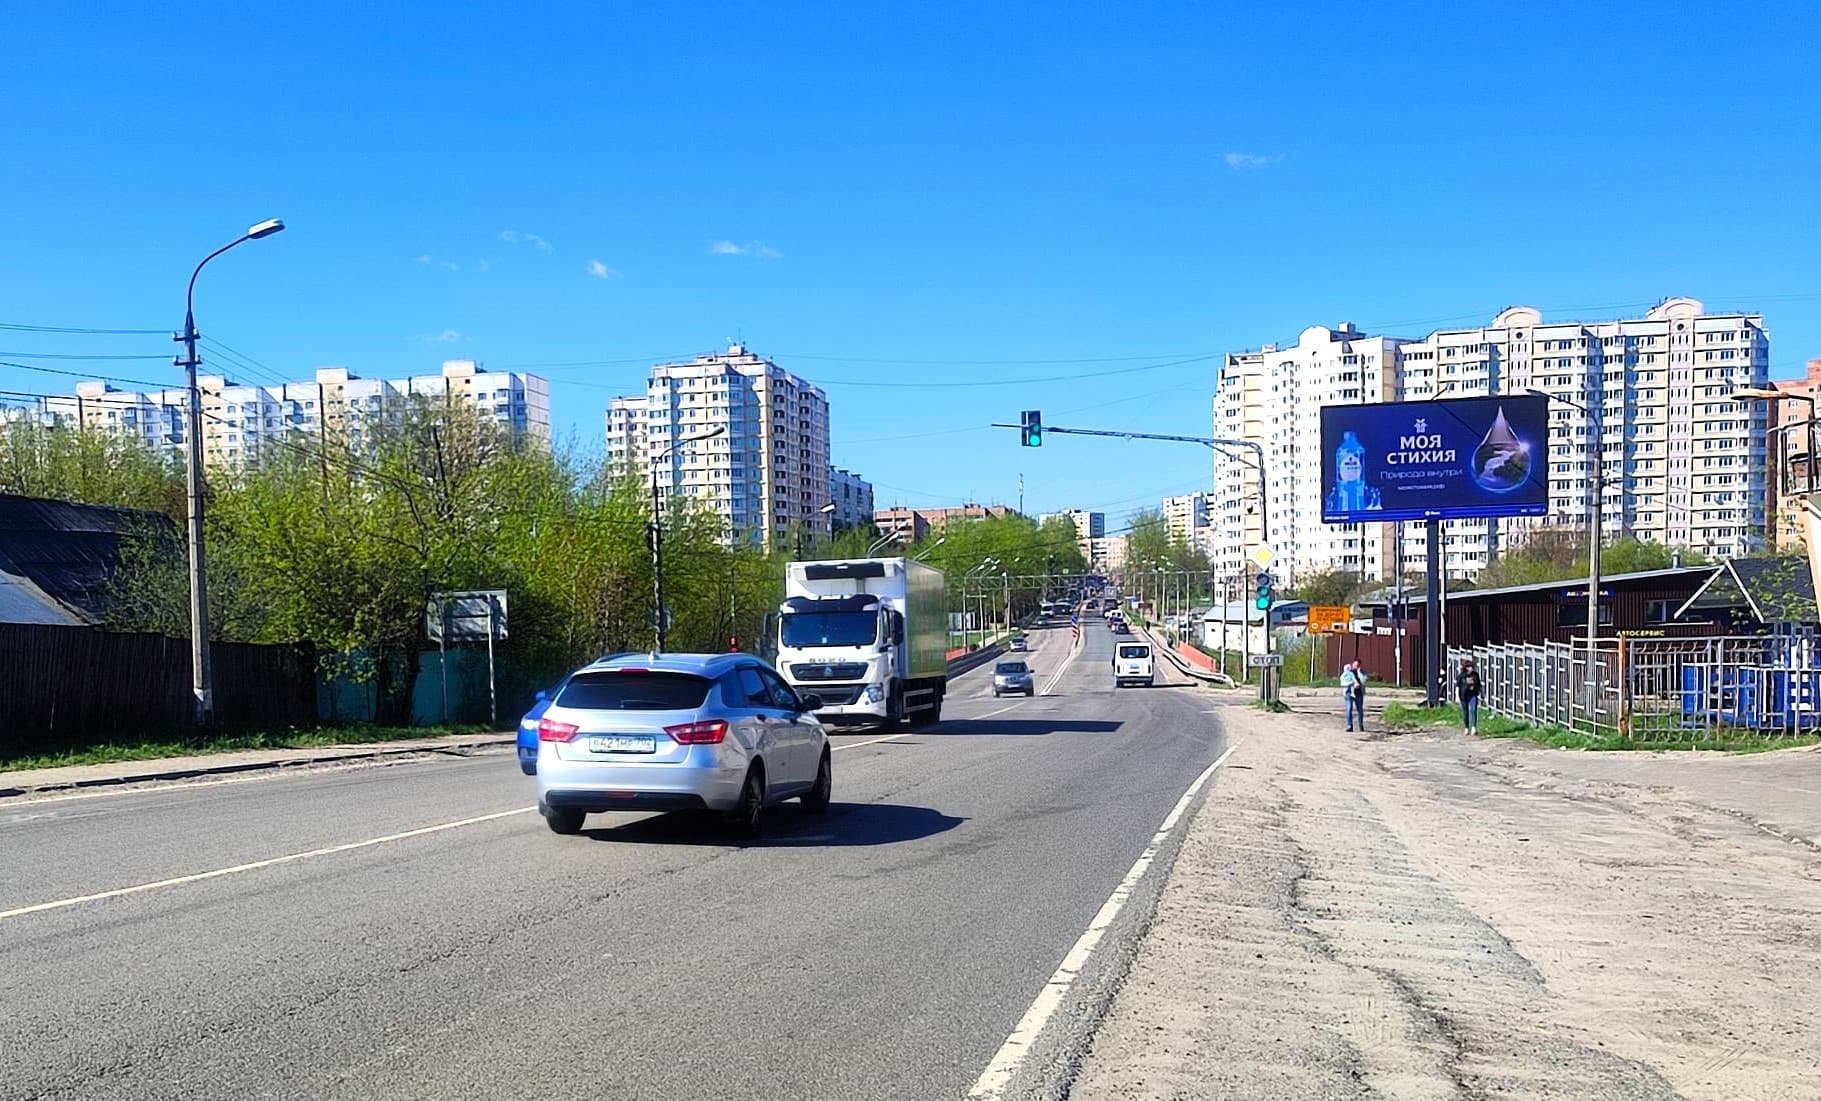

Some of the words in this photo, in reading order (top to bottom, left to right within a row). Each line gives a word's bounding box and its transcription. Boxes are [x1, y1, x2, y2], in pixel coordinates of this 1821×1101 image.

[1400, 434, 1441, 450] МОЯ
[1386, 449, 1456, 465] СТИХИЯ
[1380, 470, 1426, 480] Природа
[1427, 468, 1464, 479] внутри
[1252, 655, 1280, 665] СТОП
